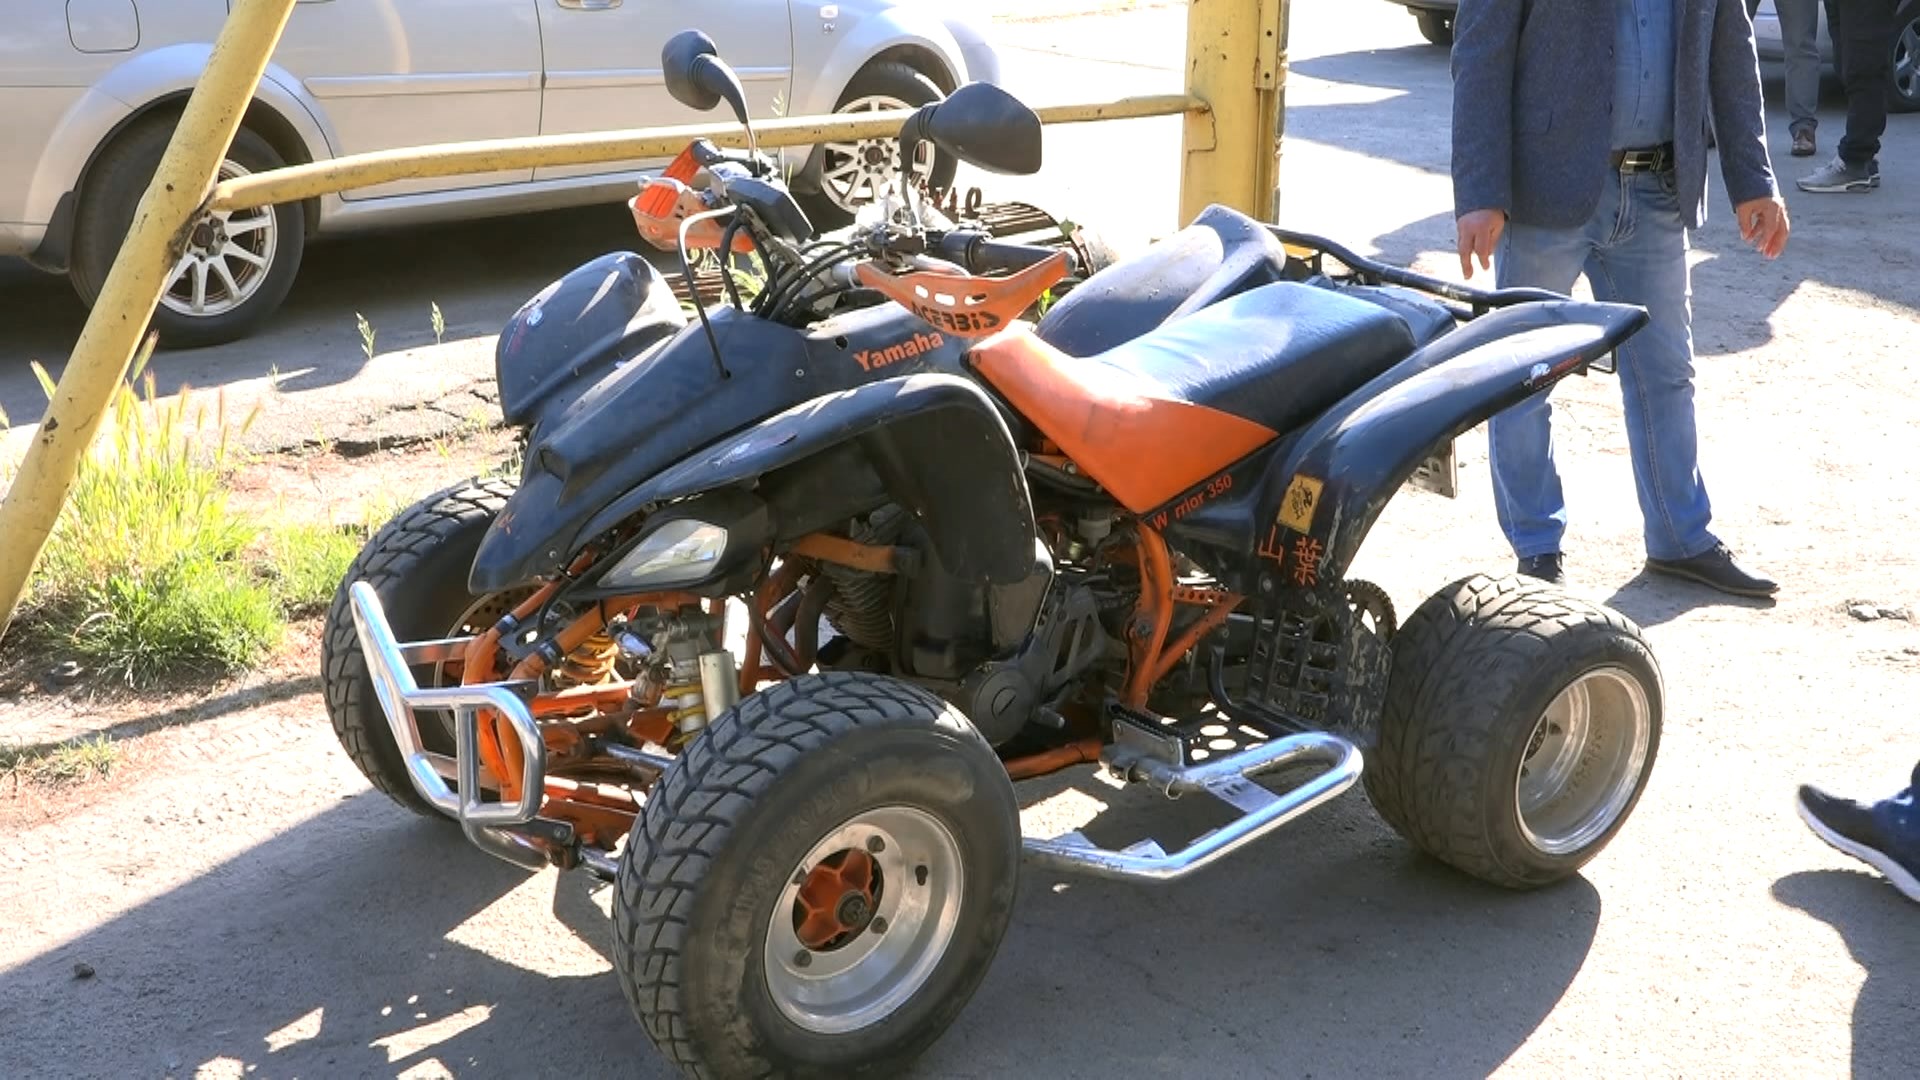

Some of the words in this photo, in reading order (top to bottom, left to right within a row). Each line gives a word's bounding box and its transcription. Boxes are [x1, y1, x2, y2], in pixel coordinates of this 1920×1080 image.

[854, 332, 944, 372] Yamaha
[1153, 491, 1205, 530] Wrrior
[1207, 474, 1232, 498] 350
